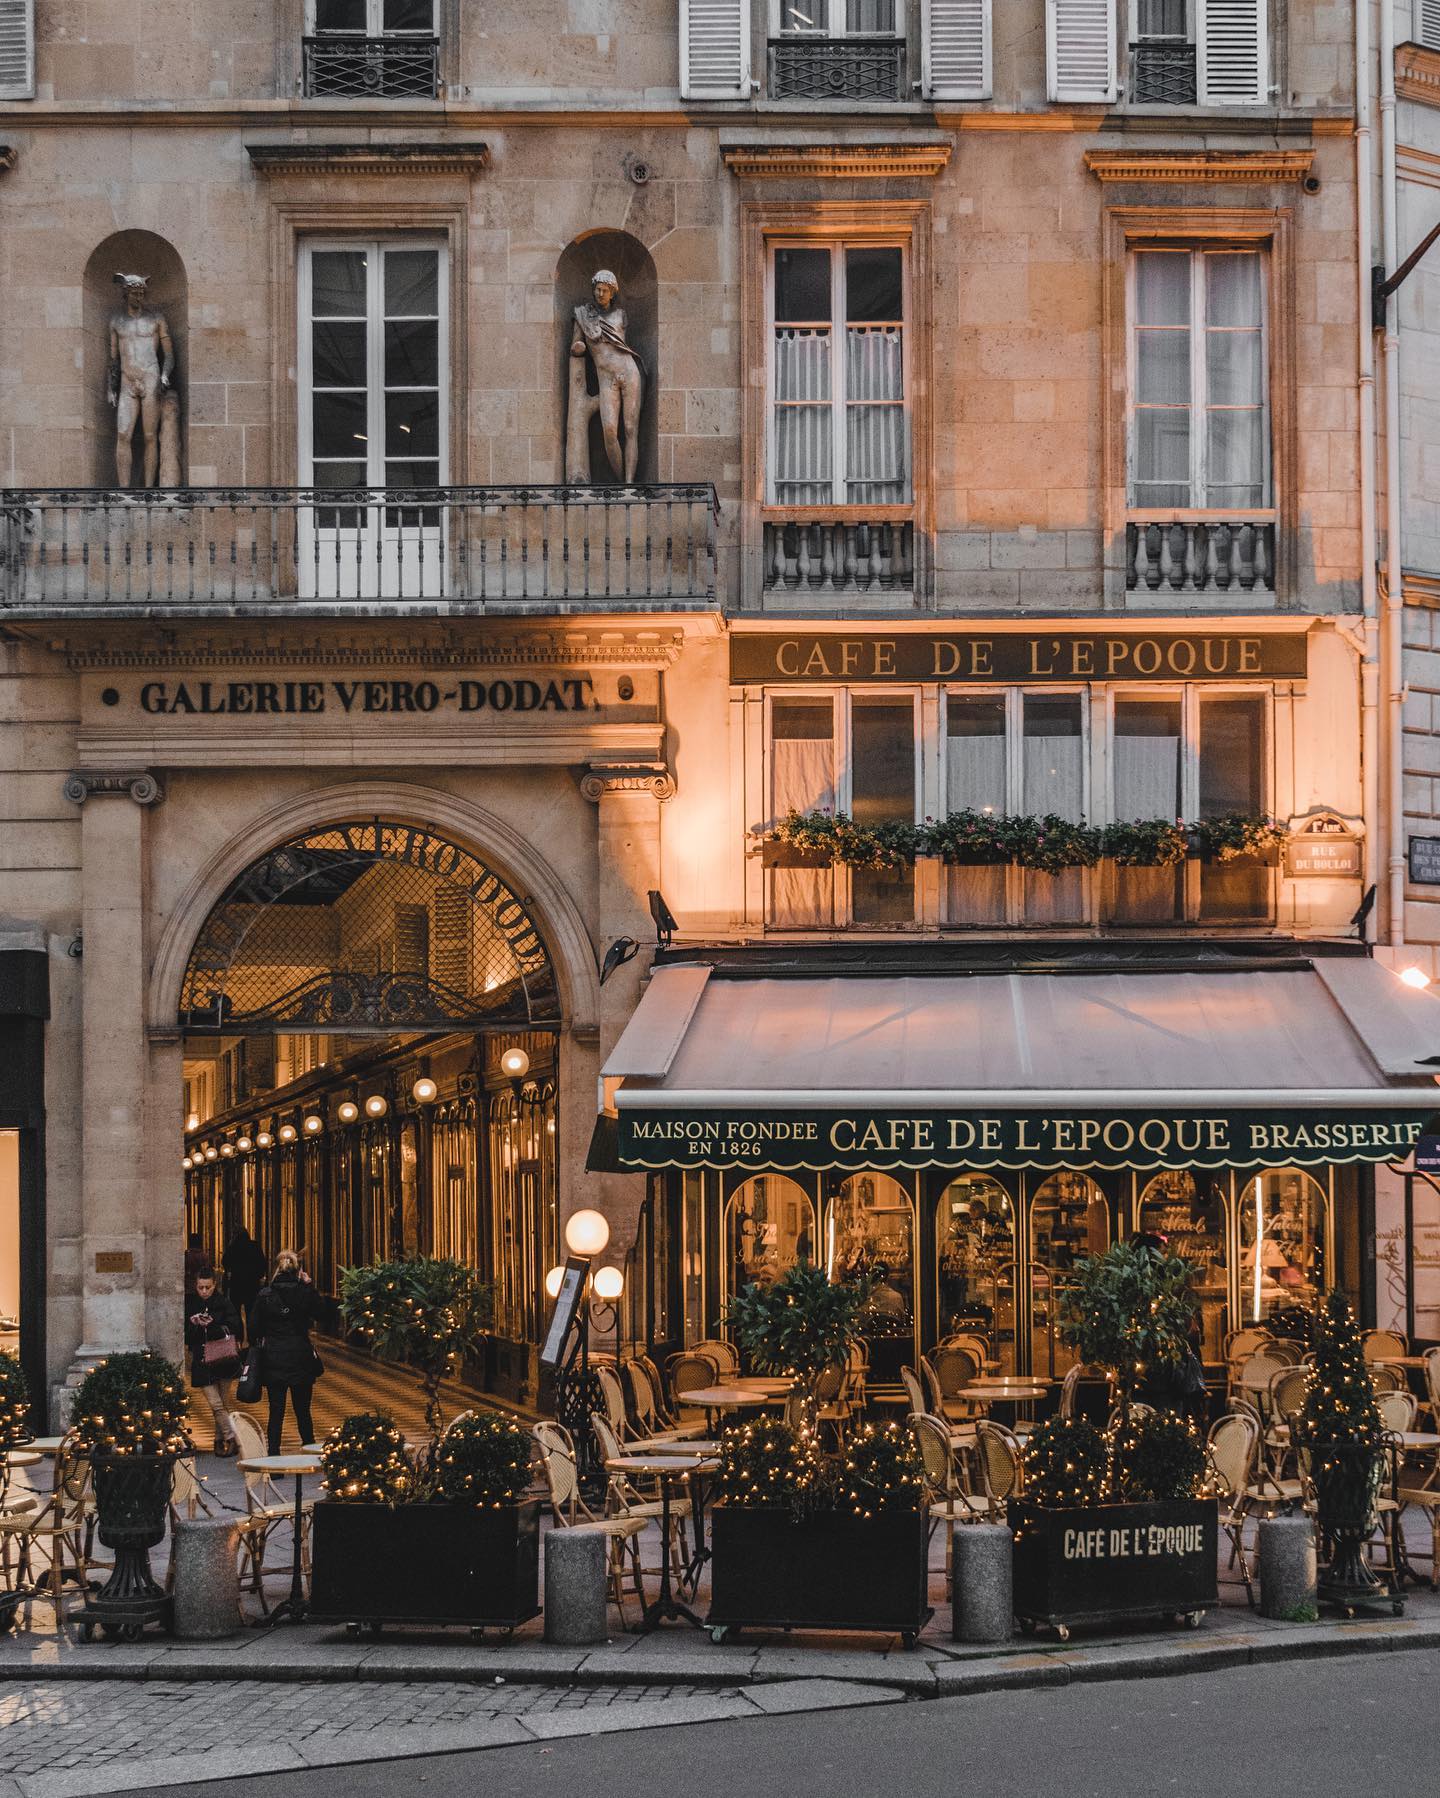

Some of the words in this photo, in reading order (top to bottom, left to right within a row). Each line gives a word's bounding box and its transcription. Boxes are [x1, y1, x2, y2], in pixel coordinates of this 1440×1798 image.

[775, 640, 898, 676] CAFE
[931, 640, 994, 676] DE
[1028, 638, 1263, 675] L'EPOQUE
[140, 681, 324, 714] GALERIE
[1296, 859, 1311, 870] DU
[1313, 859, 1352, 870] BOULOI
[1311, 846, 1337, 857] RUE
[632, 1121, 720, 1140] MAISON
[727, 1121, 818, 1141] FONDEE
[829, 1119, 935, 1152] CAFE
[947, 1119, 1002, 1151] DE
[1015, 1118, 1231, 1156] L'EPOQUE
[1249, 1122, 1423, 1149] BRASSERIE
[688, 1142, 710, 1155] EN
[719, 1141, 762, 1156] 1826
[1109, 1528, 1130, 1557] DE
